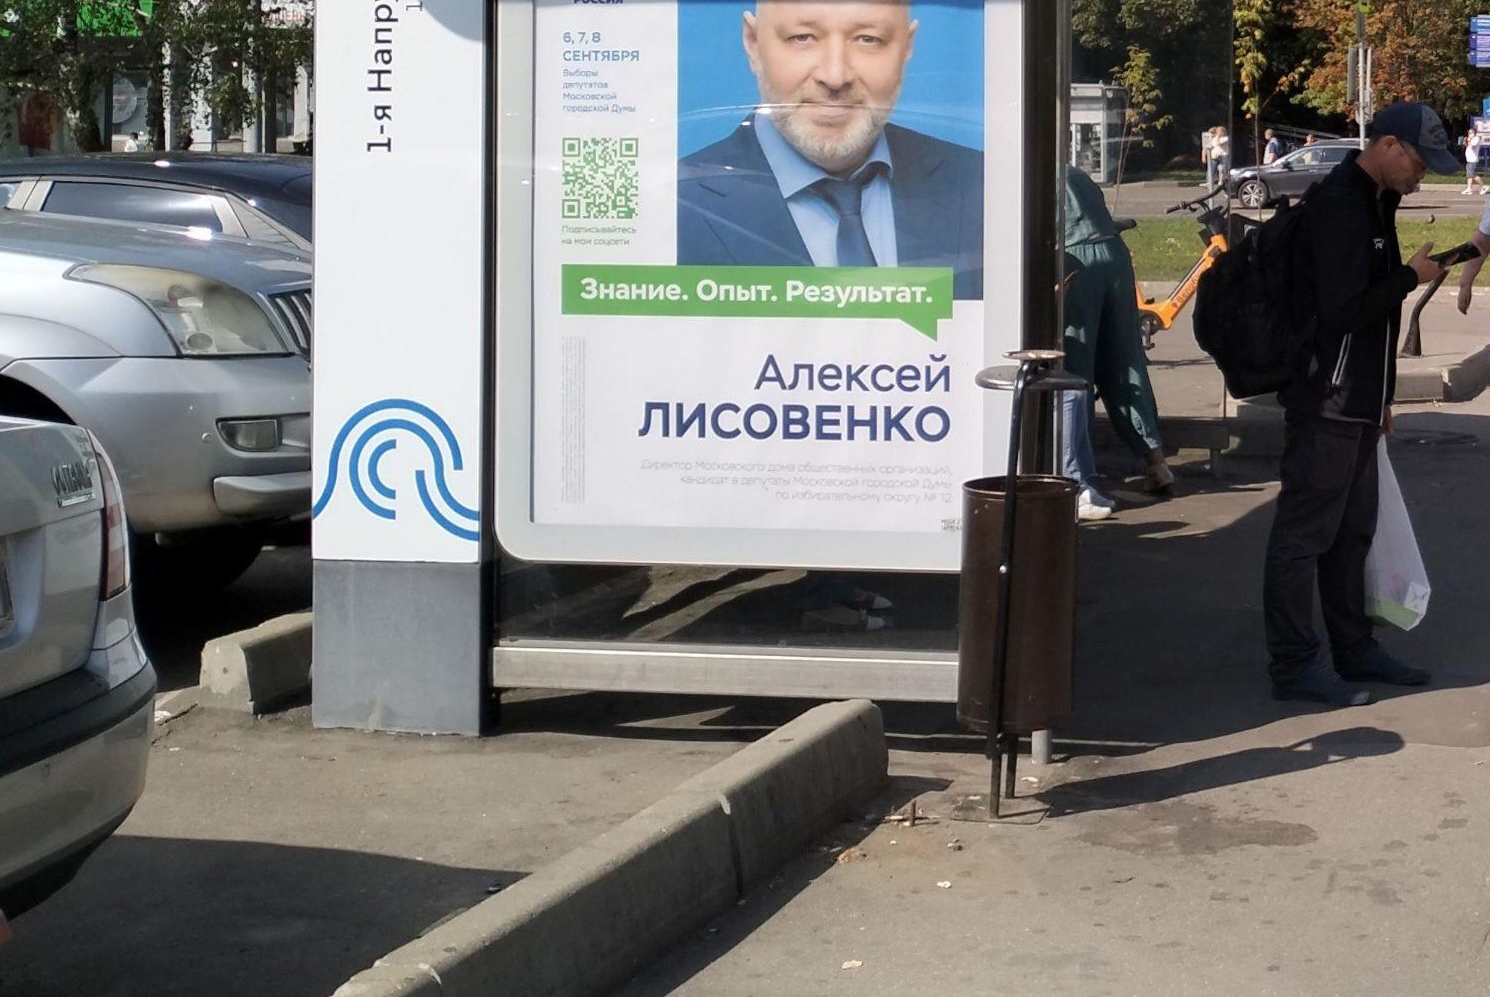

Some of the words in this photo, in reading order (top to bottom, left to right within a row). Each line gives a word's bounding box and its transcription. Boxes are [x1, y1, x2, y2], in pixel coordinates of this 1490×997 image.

[562, 32, 575, 44] 6,
[578, 32, 588, 44] 7,
[592, 32, 601, 43] 8
[562, 50, 640, 61] СЕНТЯБРЯ
[563, 69, 598, 78] Выборы
[366, 105, 392, 153] 1-я
[580, 277, 689, 301] Знание.
[696, 278, 778, 302] Опыт.
[786, 279, 933, 308] Результат.
[753, 353, 951, 393] Алексей
[637, 401, 951, 442] ЛИСОВЕНКО
